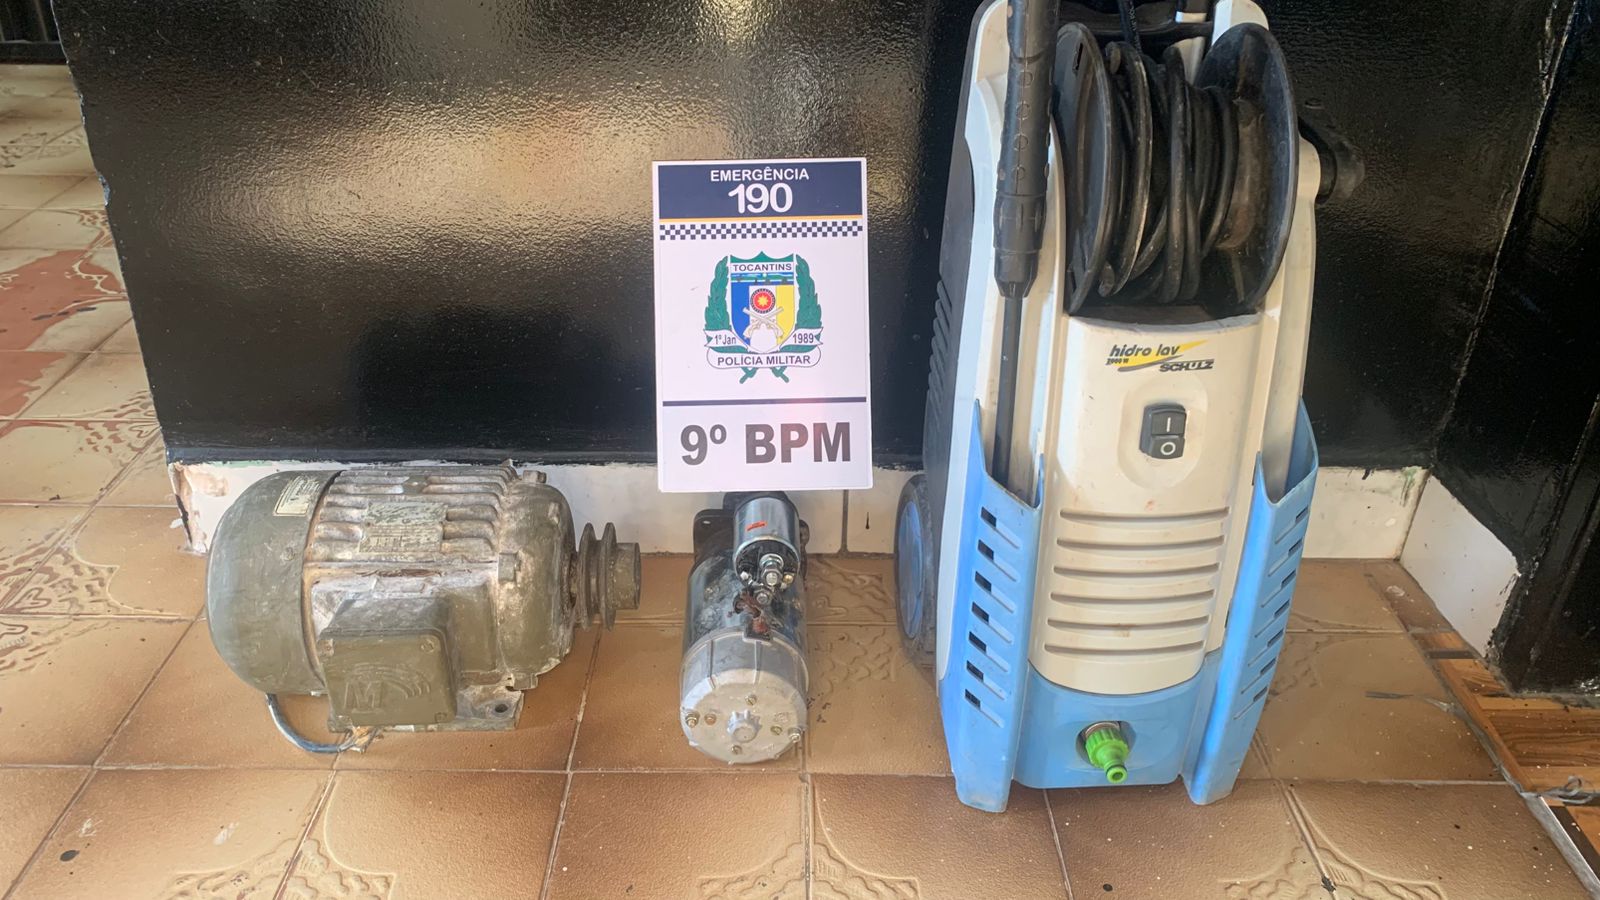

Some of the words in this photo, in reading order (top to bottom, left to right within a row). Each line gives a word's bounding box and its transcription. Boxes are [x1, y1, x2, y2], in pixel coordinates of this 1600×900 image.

[710, 167, 809, 182] EMERGÊNCIA
[728, 182, 793, 214] 190
[733, 263, 792, 272] TOCANTINS
[722, 335, 737, 345] Jan
[793, 334, 814, 344] 1989
[1109, 344, 1152, 357] hidro
[1156, 344, 1180, 356] lav
[717, 354, 763, 366] POLÍCIA
[765, 355, 811, 365] MILITAR
[1159, 359, 1215, 372] SCHULZ
[680, 424, 727, 466] 9º
[745, 422, 851, 464] BPM
